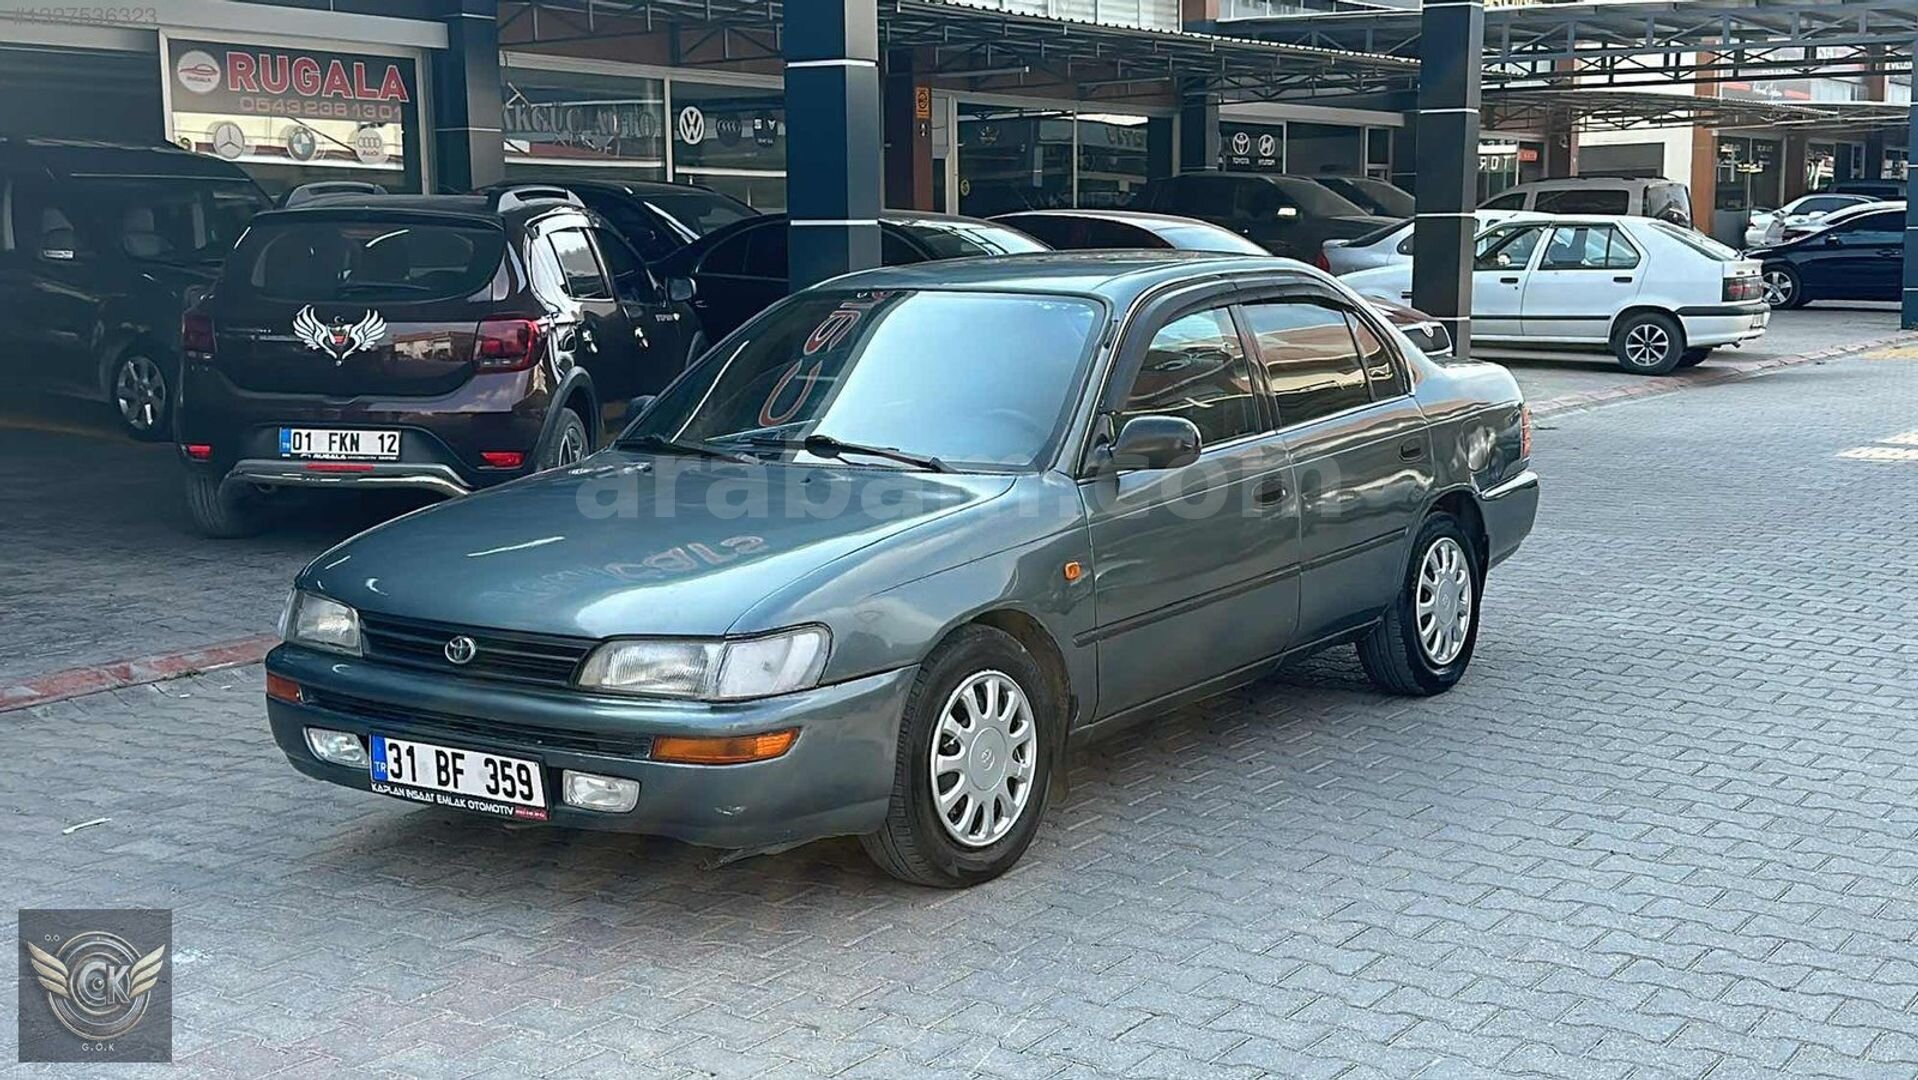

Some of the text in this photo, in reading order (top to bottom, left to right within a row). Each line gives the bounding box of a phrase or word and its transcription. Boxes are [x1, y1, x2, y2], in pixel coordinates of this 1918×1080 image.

[226, 51, 410, 102] RUGALA
[292, 431, 397, 453] 01 FKN 12
[373, 760, 387, 773] TR
[388, 742, 534, 802] 31 BF 359
[370, 782, 405, 797] KAPLAN
[437, 794, 466, 808] EMLAK
[467, 799, 514, 816] OTOMOTIV
